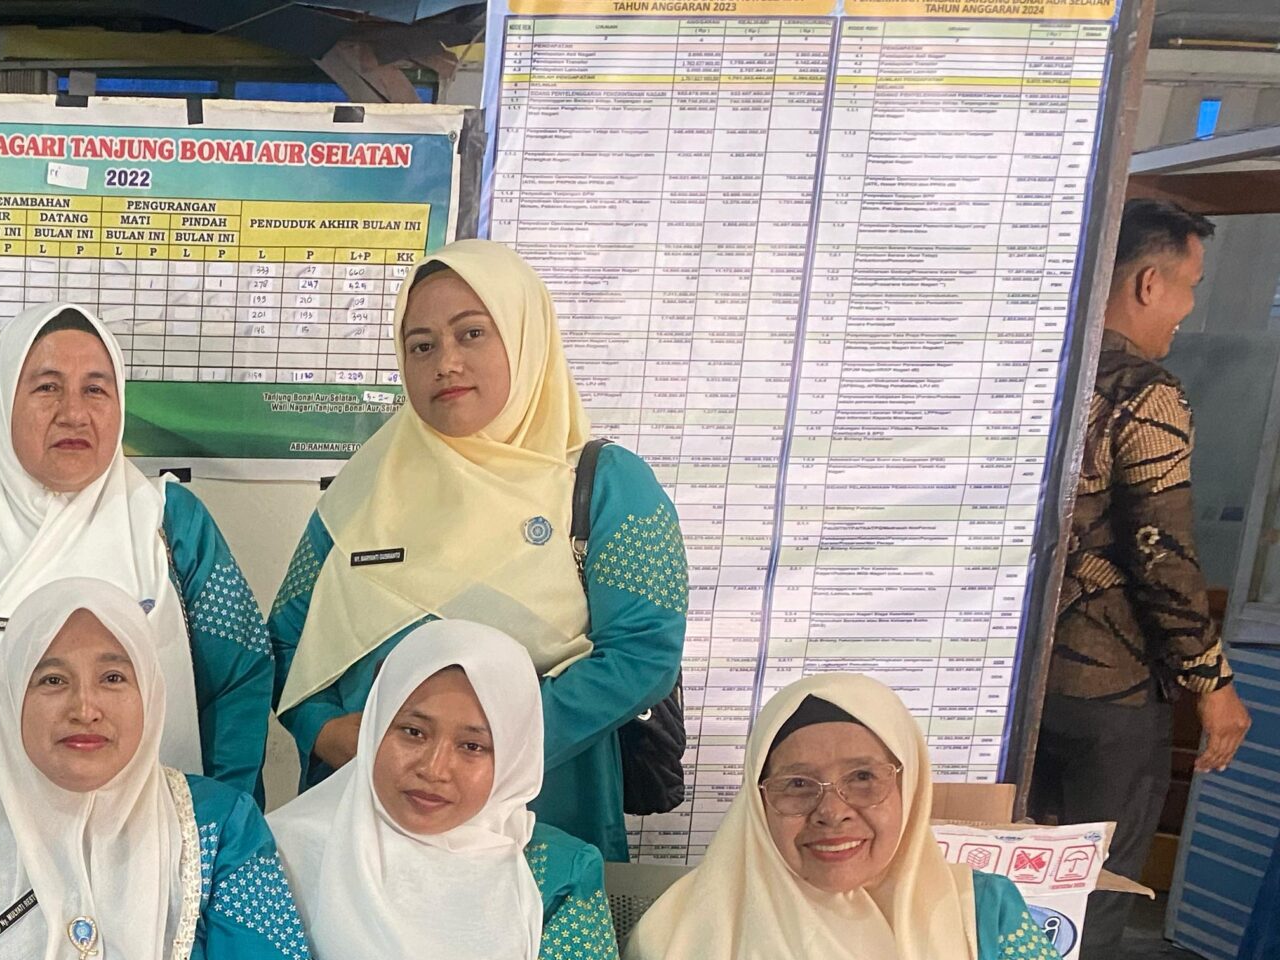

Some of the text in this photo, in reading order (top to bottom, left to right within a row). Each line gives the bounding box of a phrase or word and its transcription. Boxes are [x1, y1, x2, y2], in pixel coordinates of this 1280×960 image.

[613, 2, 737, 11] TAHUN ANGGARAN 2023
[926, 4, 1045, 14] TAHUN ANGGARAN 2024
[71, 137, 174, 160] TANJUNG
[180, 140, 254, 162] BONAI
[258, 143, 305, 164] AUR
[310, 143, 411, 165] SELATAN
[106, 169, 151, 187] 2022
[127, 201, 216, 212] PENGURANGAN
[40, 213, 88, 223] DATANG
[120, 215, 150, 225] MATI
[182, 217, 227, 227] PINDAH
[250, 218, 421, 231] PENDUDUK AKHIR BULAN INI
[4, 227, 21, 237] INI
[34, 228, 94, 239] BULAN INI
[106, 230, 165, 241] BULAN INI
[175, 232, 235, 243] BULAN INI
[5, 244, 12, 252] P
[40, 245, 47, 253] L
[77, 246, 84, 254] P
[116, 247, 122, 255] L
[150, 248, 157, 256] P
[183, 249, 190, 257] L
[219, 250, 226, 258] P
[259, 251, 265, 259] L
[306, 251, 314, 259] P
[350, 252, 371, 261] L+P
[397, 253, 414, 262] KK
[263, 393, 291, 402] Tanjung
[315, 394, 329, 402] Aur
[271, 403, 288, 411] Wali
[290, 403, 313, 413] Nagari
[315, 404, 342, 413] Tanjung
[381, 405, 402, 413] Selat
